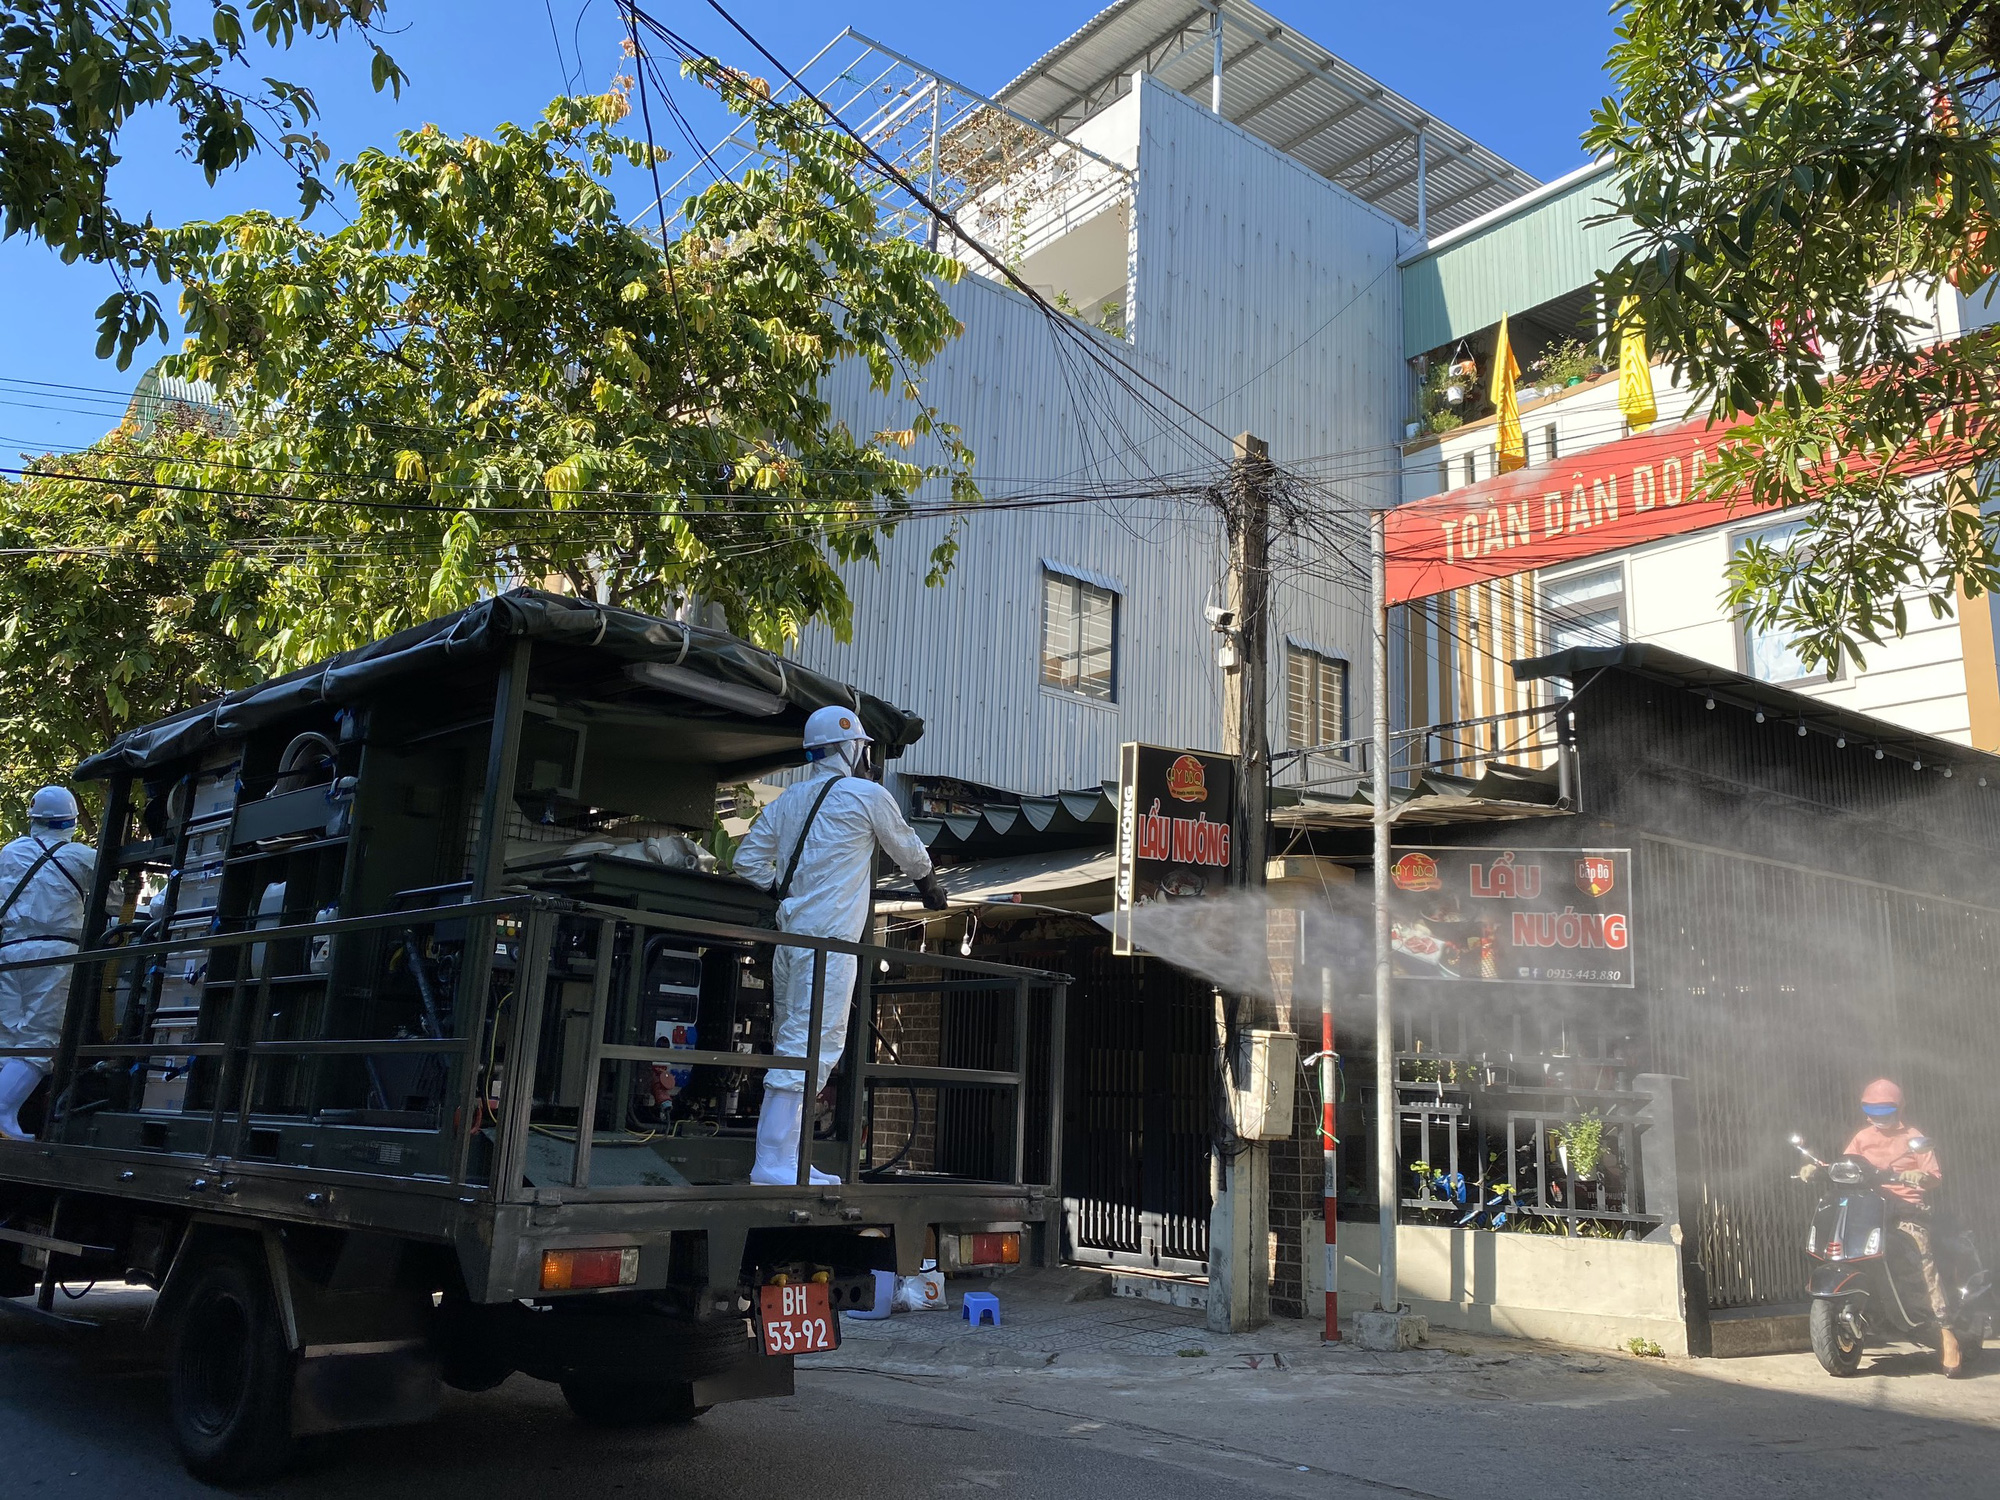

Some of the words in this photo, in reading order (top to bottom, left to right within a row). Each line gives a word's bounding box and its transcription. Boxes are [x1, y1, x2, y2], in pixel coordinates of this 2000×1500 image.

[1441, 497, 1531, 565] TOÀN
[1543, 471, 1619, 538] DÂN
[1185, 770, 1202, 787] BBQ
[1138, 797, 1171, 861] LẨU
[1172, 811, 1230, 867] NƯỚNG
[1412, 865, 1435, 878] BBQ
[1470, 851, 1541, 899] LẨU
[1579, 861, 1596, 883] Cấp
[1597, 864, 1609, 882] Độ
[1512, 906, 1628, 950] NƯỚNG
[1546, 968, 1621, 981] 0915.443.880
[783, 1286, 807, 1316] BH
[768, 1318, 828, 1351] 53-92
